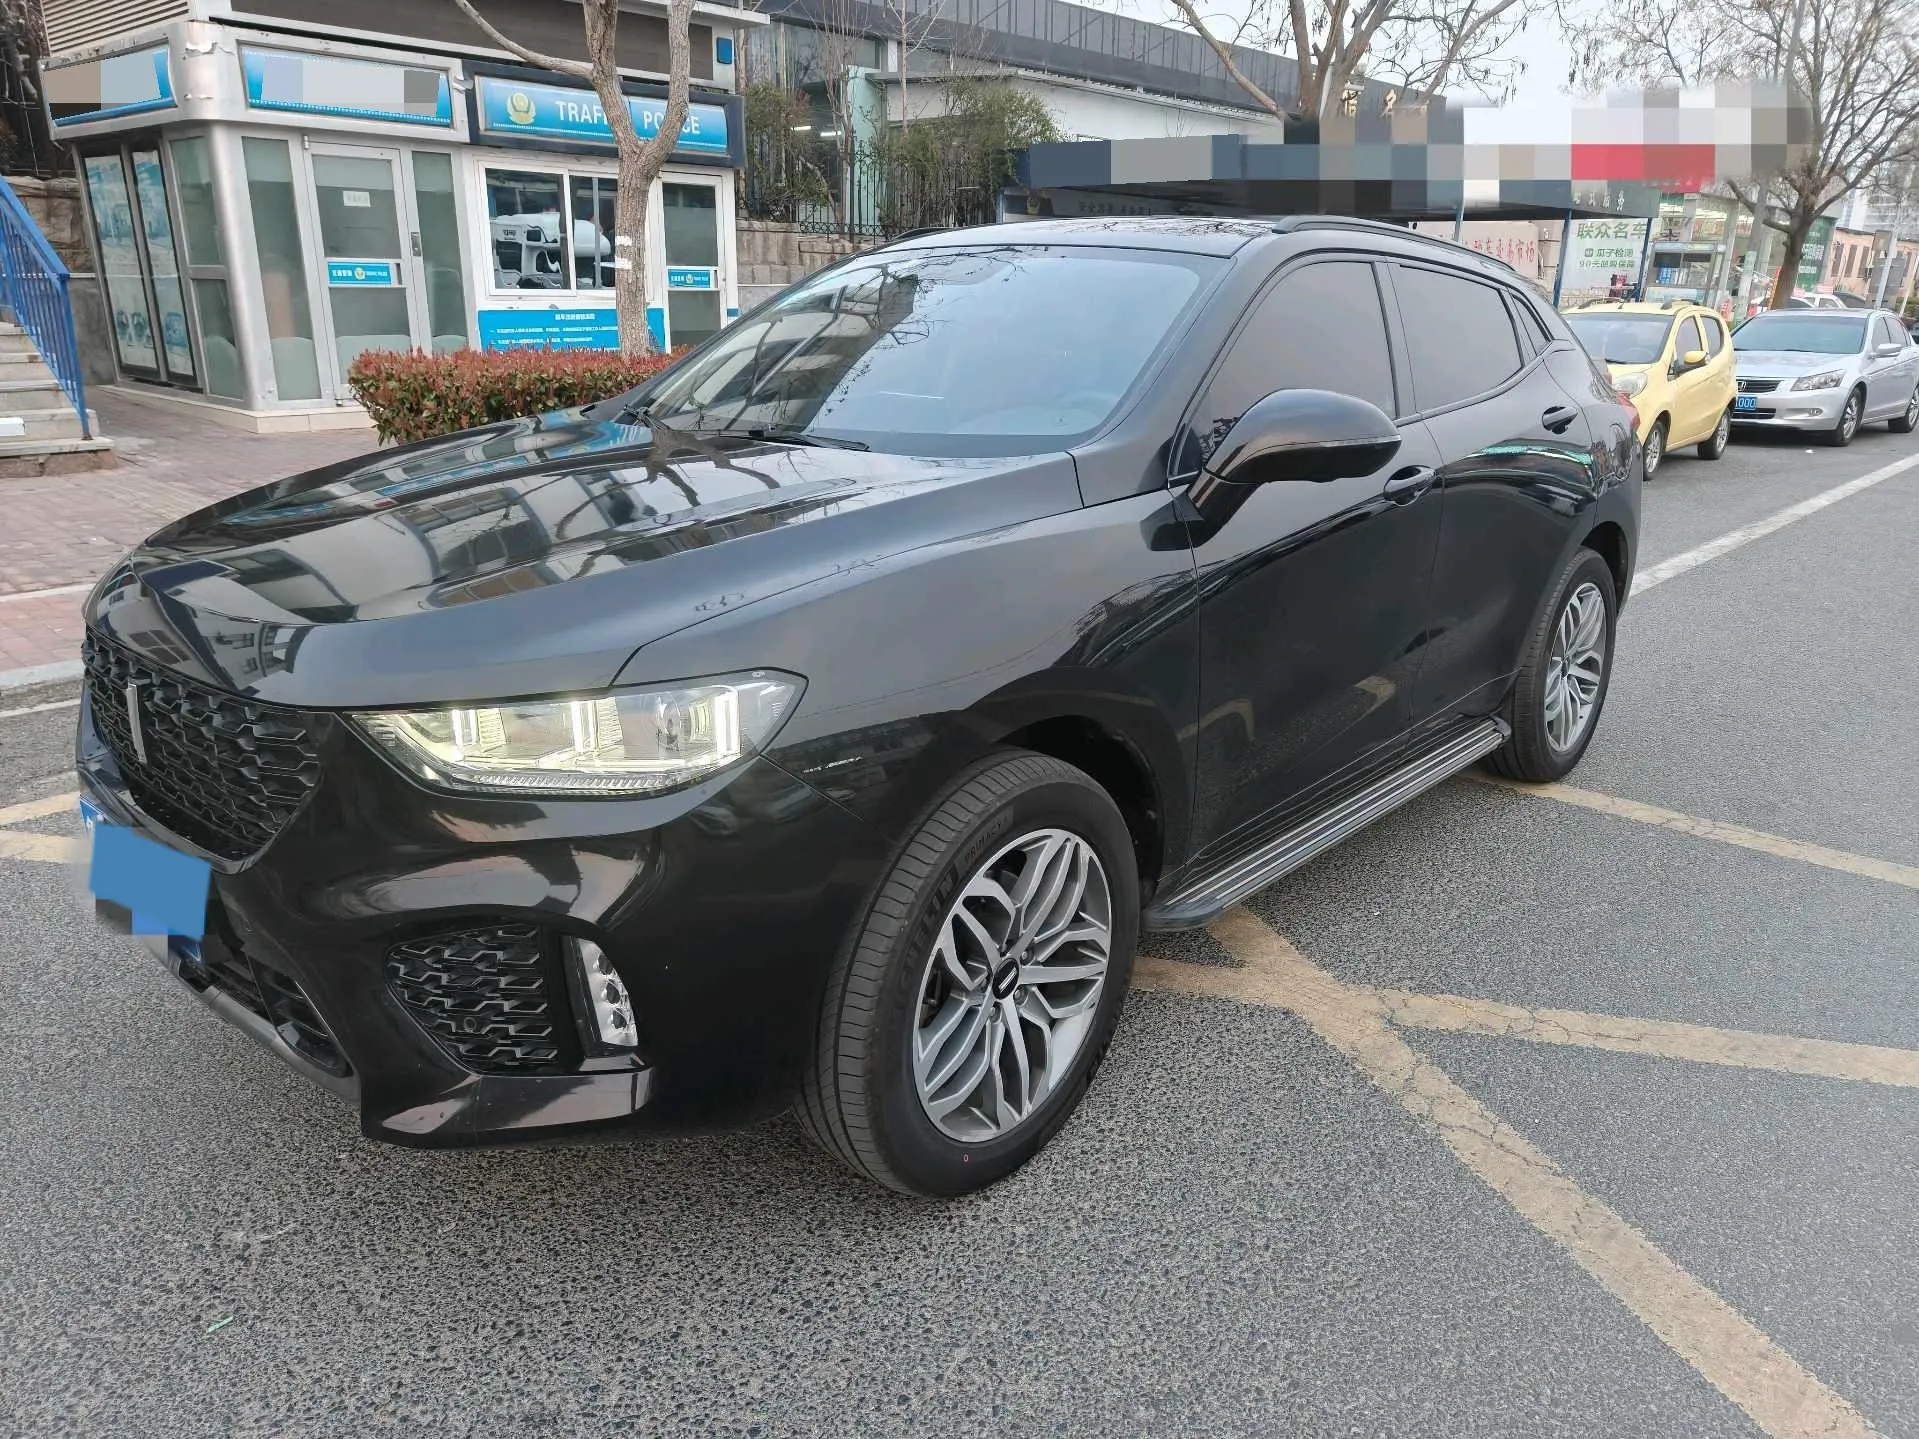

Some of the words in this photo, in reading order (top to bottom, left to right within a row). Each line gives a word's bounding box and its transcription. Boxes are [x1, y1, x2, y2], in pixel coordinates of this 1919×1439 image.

[555, 101, 608, 125] TRAF
[643, 111, 701, 134] POCE
[1577, 222, 1647, 239] 联众名车
